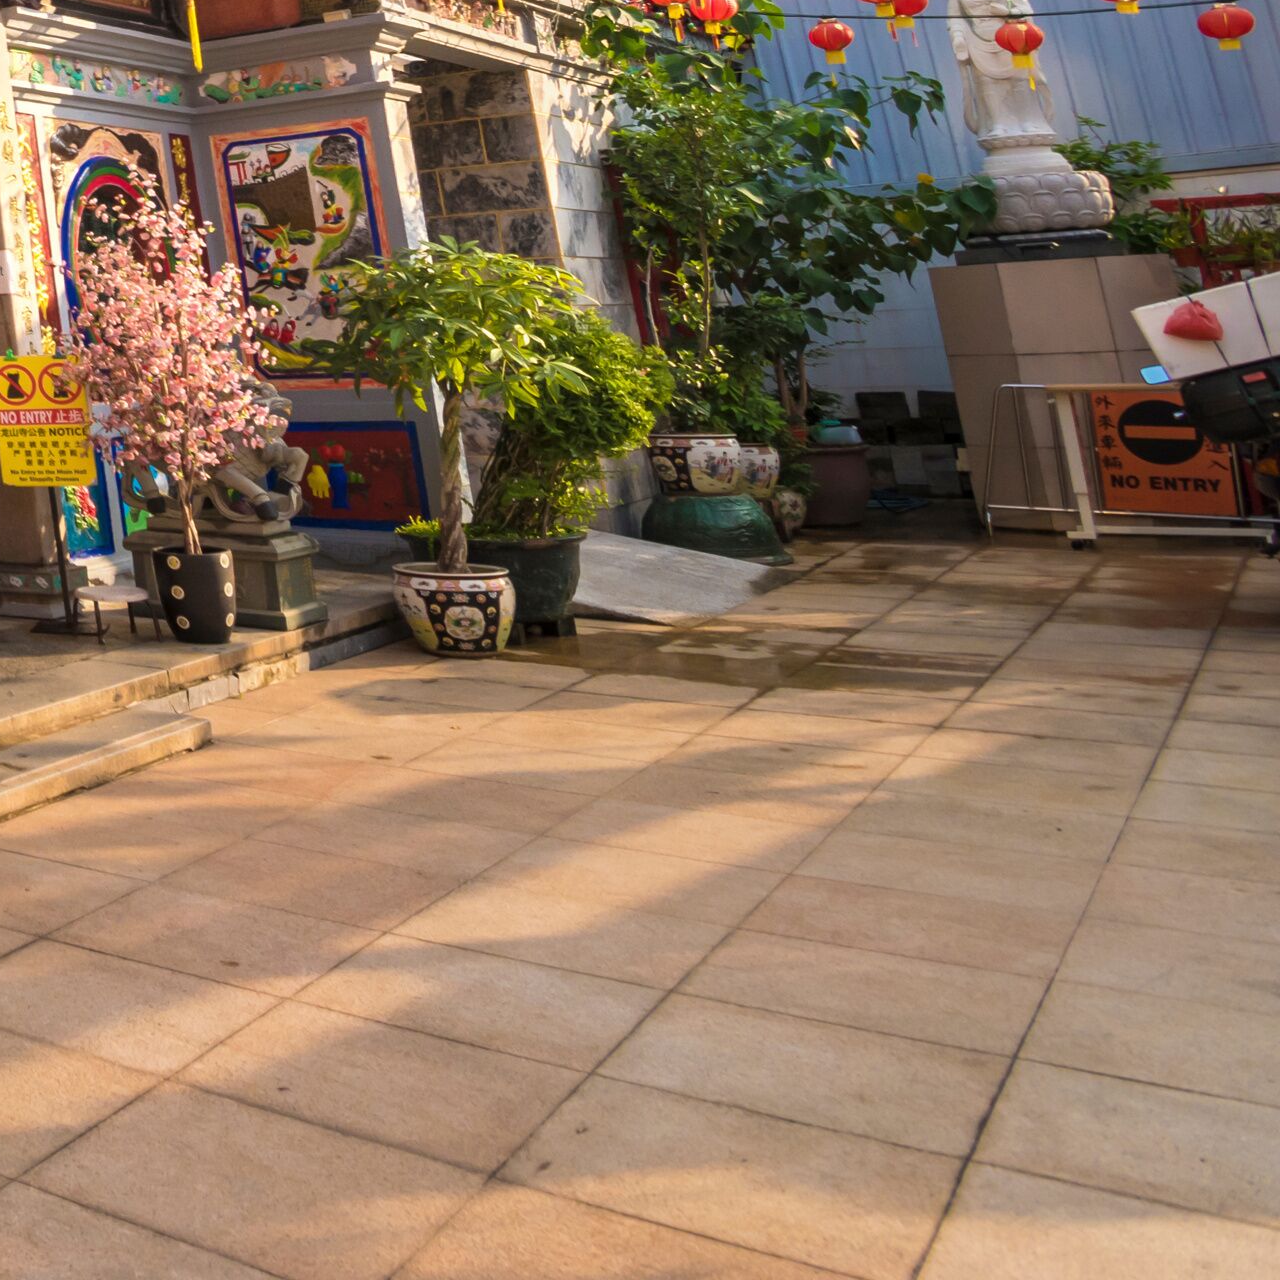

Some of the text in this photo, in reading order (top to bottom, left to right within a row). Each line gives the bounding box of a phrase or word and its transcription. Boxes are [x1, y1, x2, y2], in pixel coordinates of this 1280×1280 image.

[0, 410, 17, 424] NO
[20, 410, 52, 424] ENTRY
[1110, 474, 1221, 493] NO ENTRY
